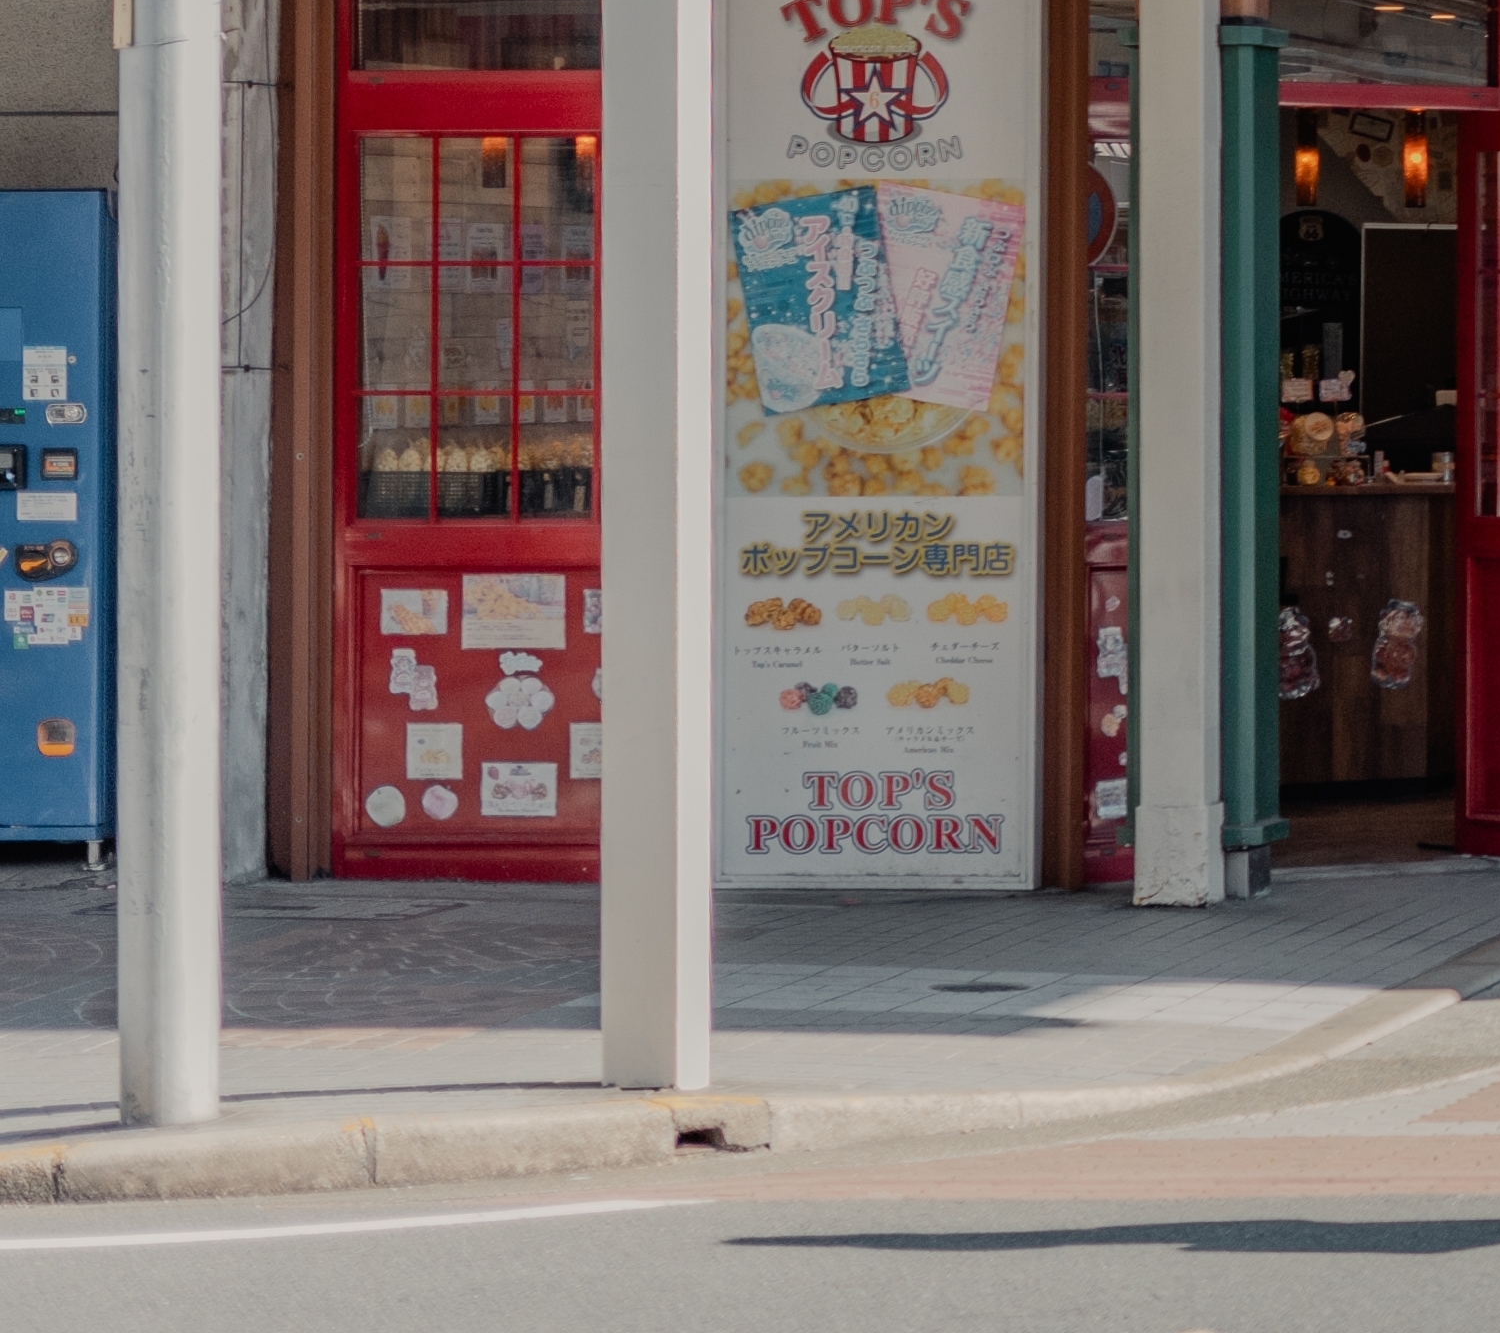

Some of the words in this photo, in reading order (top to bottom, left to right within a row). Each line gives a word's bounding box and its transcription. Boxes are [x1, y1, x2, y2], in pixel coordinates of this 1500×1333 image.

[868, 92, 880, 109] 6
[786, 134, 964, 172] POPCORN
[800, 215, 844, 390] アイスクリーム
[1282, 288, 1352, 302] IGHWAY
[804, 511, 955, 541] アメリカン
[740, 543, 1014, 576] ポップコーン専門店
[802, 768, 956, 810] TOP'S
[746, 814, 1004, 855] POPCORN
